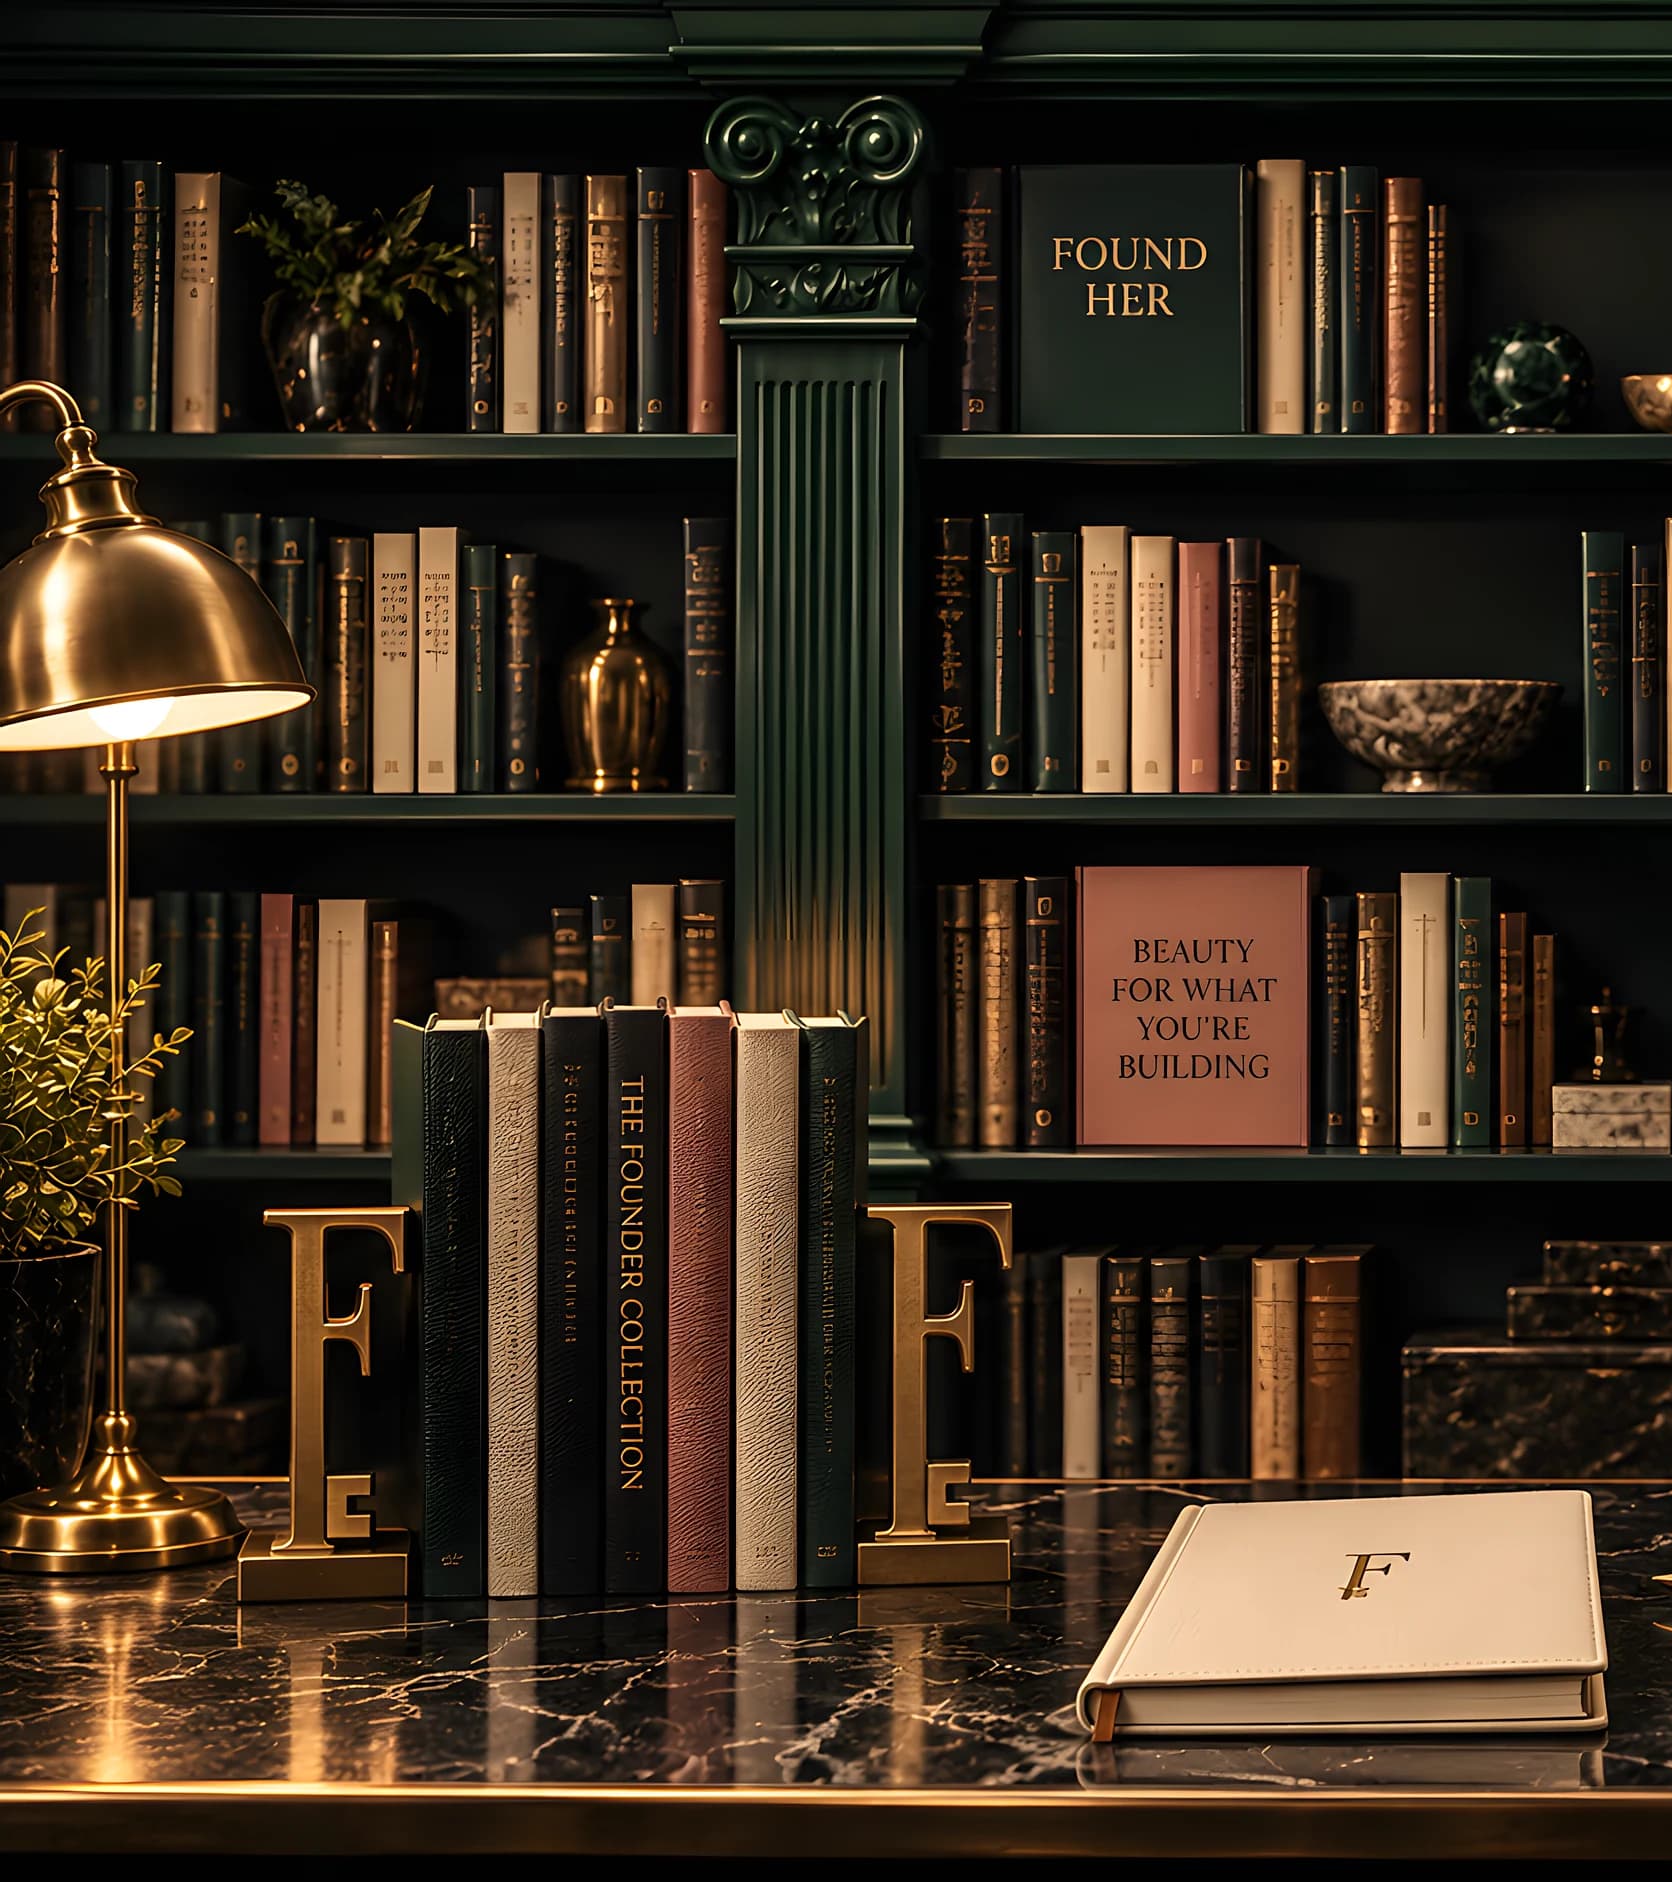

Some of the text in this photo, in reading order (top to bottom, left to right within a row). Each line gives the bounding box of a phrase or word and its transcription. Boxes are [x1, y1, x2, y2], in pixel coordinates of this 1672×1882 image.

[1053, 238, 1206, 270] FOUND
[1087, 284, 1173, 315] HER
[1134, 939, 1253, 963] BEAUTY
[1112, 978, 1277, 1002] FOR WHAT
[1137, 1016, 1250, 1040] YOU'RE
[1119, 1055, 1268, 1079] BUILDING
[621, 1076, 643, 1488] THE FOUNDER COLLECTION
